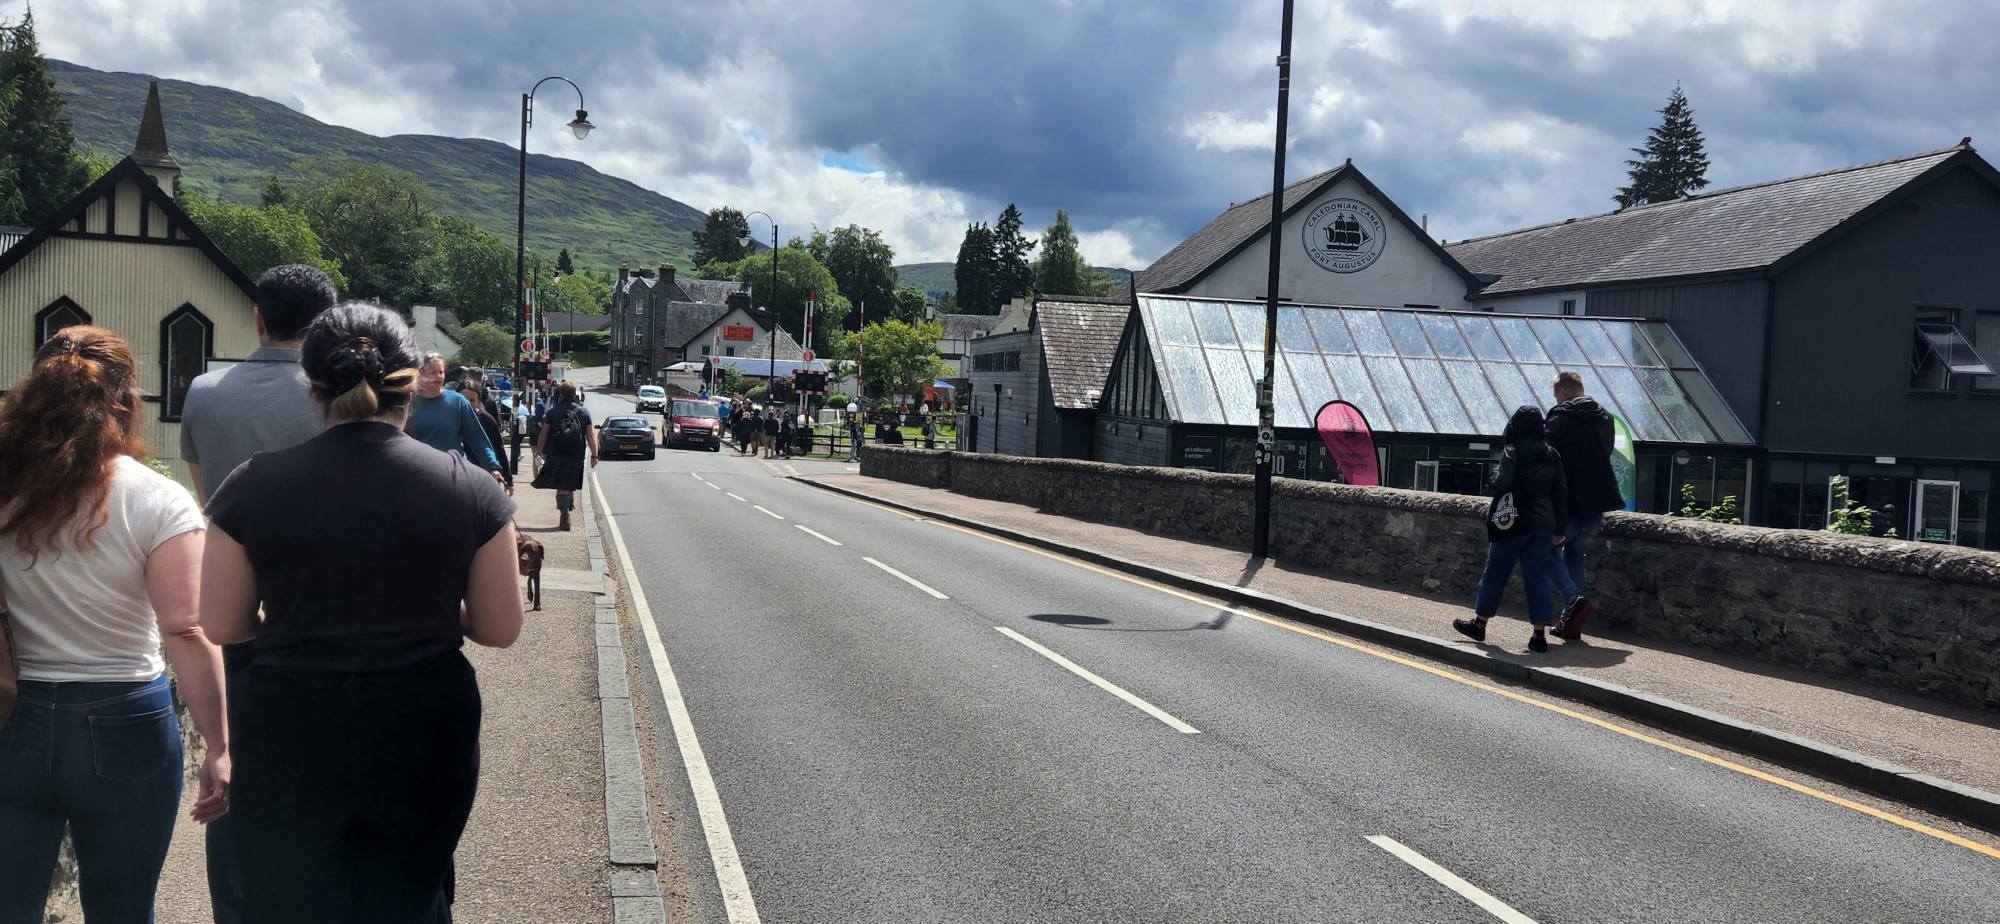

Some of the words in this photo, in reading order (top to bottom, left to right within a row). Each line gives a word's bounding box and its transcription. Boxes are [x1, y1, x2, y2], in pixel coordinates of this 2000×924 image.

[1308, 202, 1358, 228] CALEDONIAN
[1360, 207, 1382, 232] CANAL
[1310, 248, 1330, 265] FORT
[1332, 251, 1376, 269] AUGUSTUS
